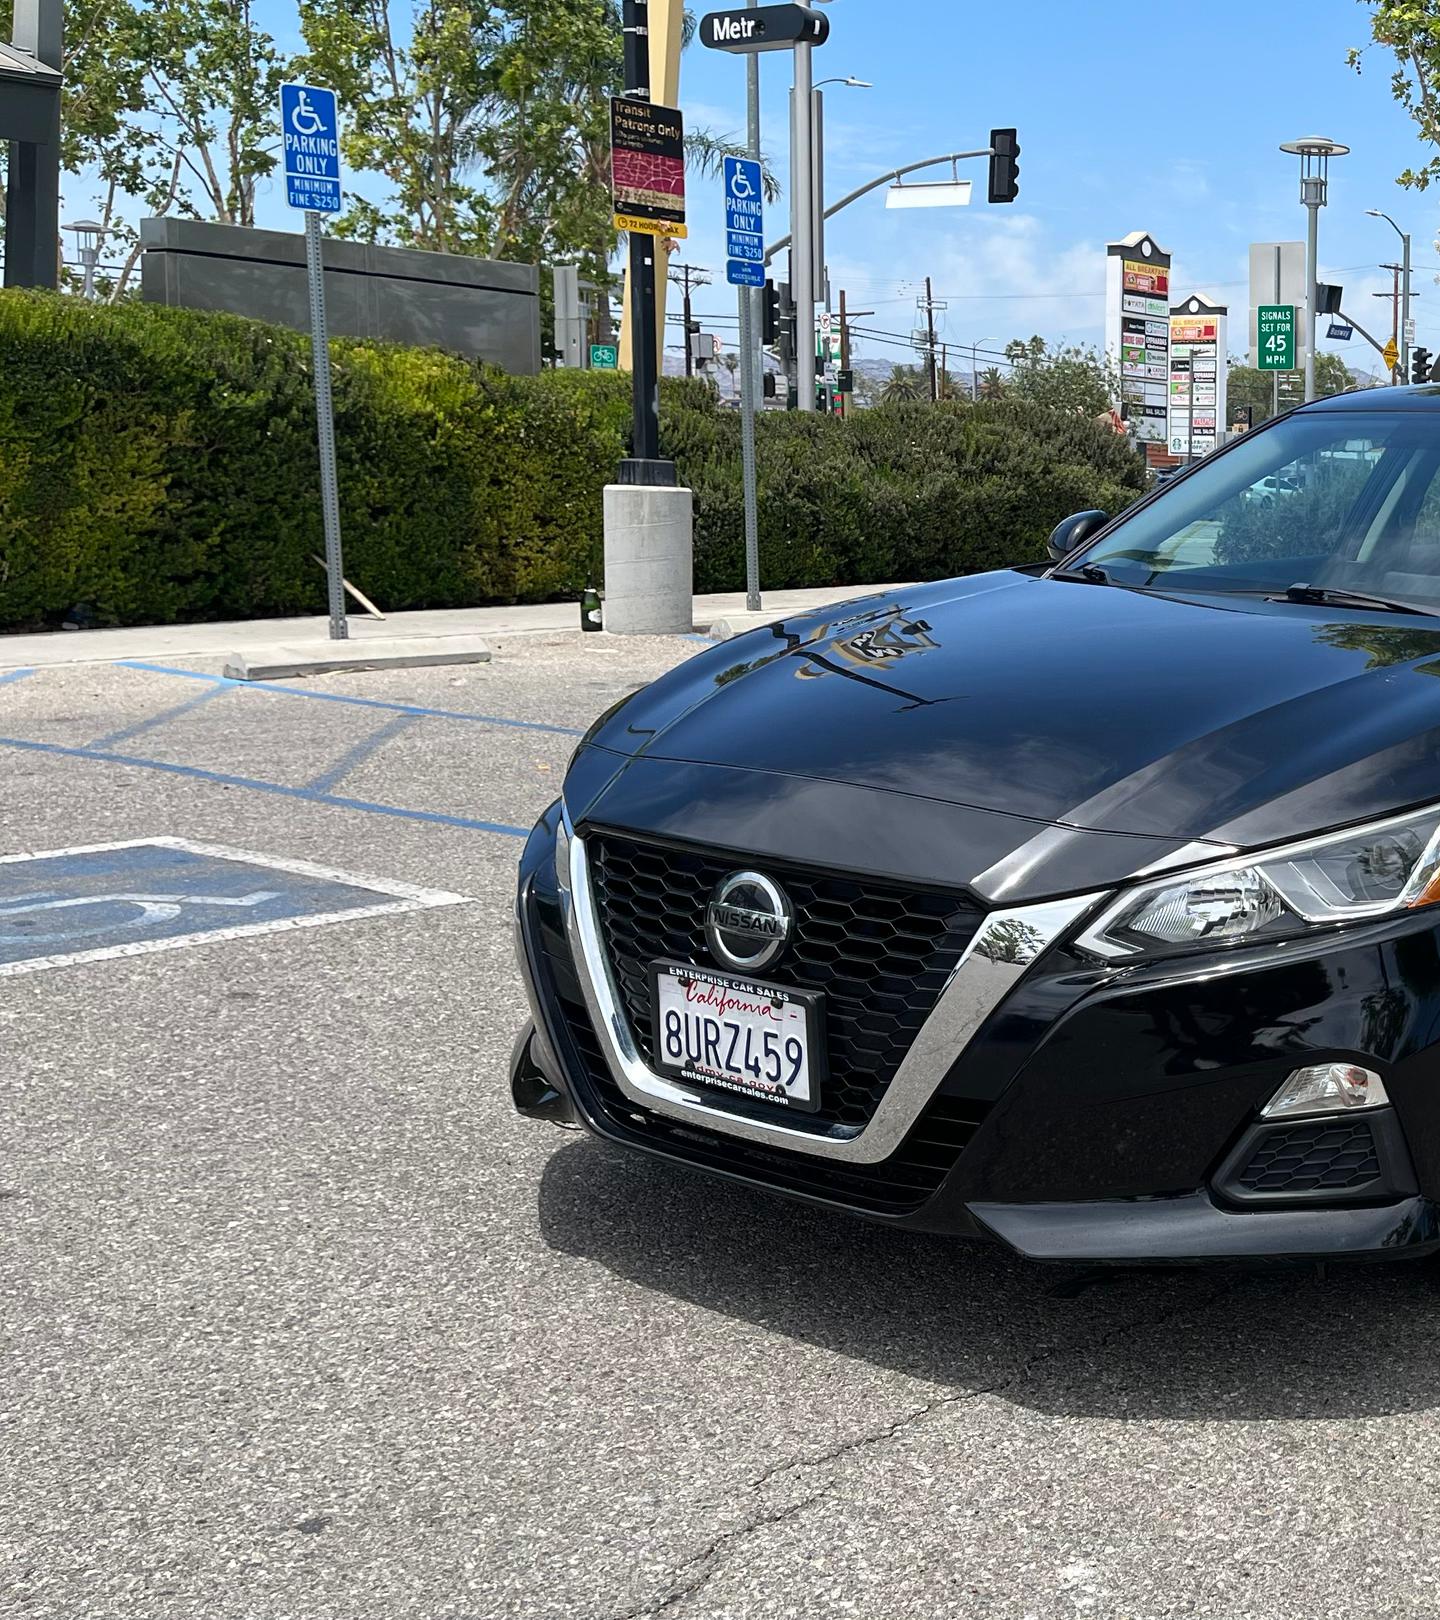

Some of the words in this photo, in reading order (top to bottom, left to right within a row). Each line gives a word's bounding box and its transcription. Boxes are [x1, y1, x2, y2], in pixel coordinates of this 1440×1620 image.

[614, 101, 652, 118] Transit
[614, 115, 656, 133] Patrons
[657, 123, 681, 140] Only
[285, 133, 337, 157] PARKING
[296, 155, 328, 175] ONLY
[294, 178, 334, 194] MINIMUM
[290, 192, 310, 206] FINE
[312, 194, 339, 209] $250
[726, 196, 762, 217] PARKING
[629, 220, 638, 228] 72
[733, 214, 755, 231] ONLY
[731, 233, 759, 246] MINIMUM
[728, 244, 743, 256] FINE
[744, 246, 762, 259] $250
[1126, 262, 1137, 271] ALL
[1137, 264, 1169, 277] BREAKFAST
[1261, 310, 1291, 320] SIGNALS
[1261, 323, 1274, 332] SET
[1276, 323, 1291, 332] FOR
[1265, 335, 1287, 352] 45
[1265, 355, 1286, 365] MPH
[714, 908, 778, 934] NISSAN
[669, 967, 730, 988] ENTERPRISE
[732, 981, 754, 994] CAR
[756, 987, 790, 1002] SALES
[685, 979, 784, 1022] California
[665, 1009, 804, 1087] 8URZ459
[680, 1069, 789, 1106] enterprisecarsales.com
